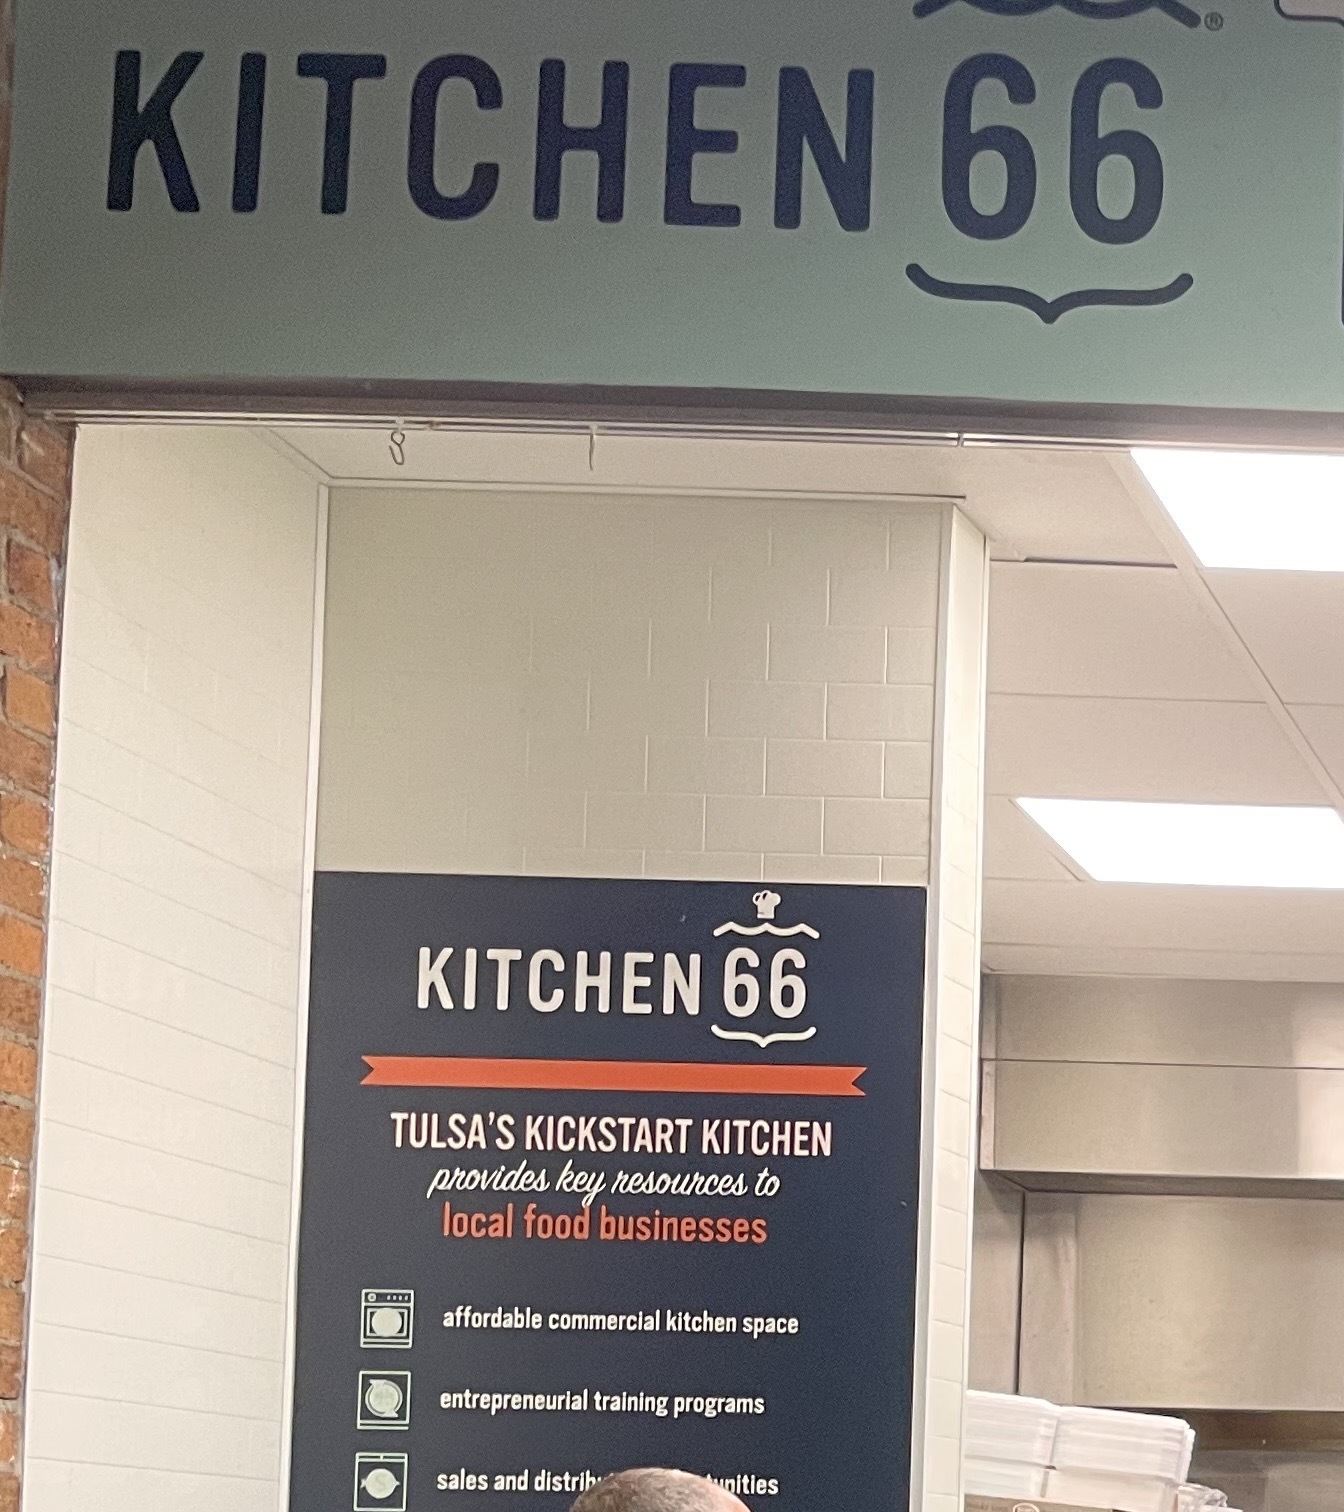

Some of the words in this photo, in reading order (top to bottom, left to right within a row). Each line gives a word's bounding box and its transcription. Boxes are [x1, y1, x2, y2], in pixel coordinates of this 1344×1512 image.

[106, 49, 875, 232] KITCHEN
[941, 52, 1165, 244] 66
[417, 946, 701, 1016] KITCHEN
[723, 947, 808, 1018] 66
[391, 1111, 516, 1152] TULSA'S
[525, 1115, 694, 1154] KICKSTART
[702, 1119, 833, 1157] KITCHEN
[427, 1160, 550, 1200] provides
[555, 1159, 607, 1207] key
[611, 1170, 748, 1197] resources
[754, 1166, 781, 1197] to
[442, 1201, 514, 1239] local
[524, 1203, 591, 1241] food
[600, 1205, 768, 1243] businesses
[443, 1306, 543, 1330] affordable
[549, 1309, 660, 1332] commercial
[666, 1310, 737, 1333] kitchen
[742, 1315, 799, 1339] space
[440, 1388, 589, 1416] entrepreneurial
[594, 1391, 669, 1418] training
[673, 1394, 766, 1419] programs
[436, 1467, 489, 1491] sales
[494, 1469, 529, 1492] and
